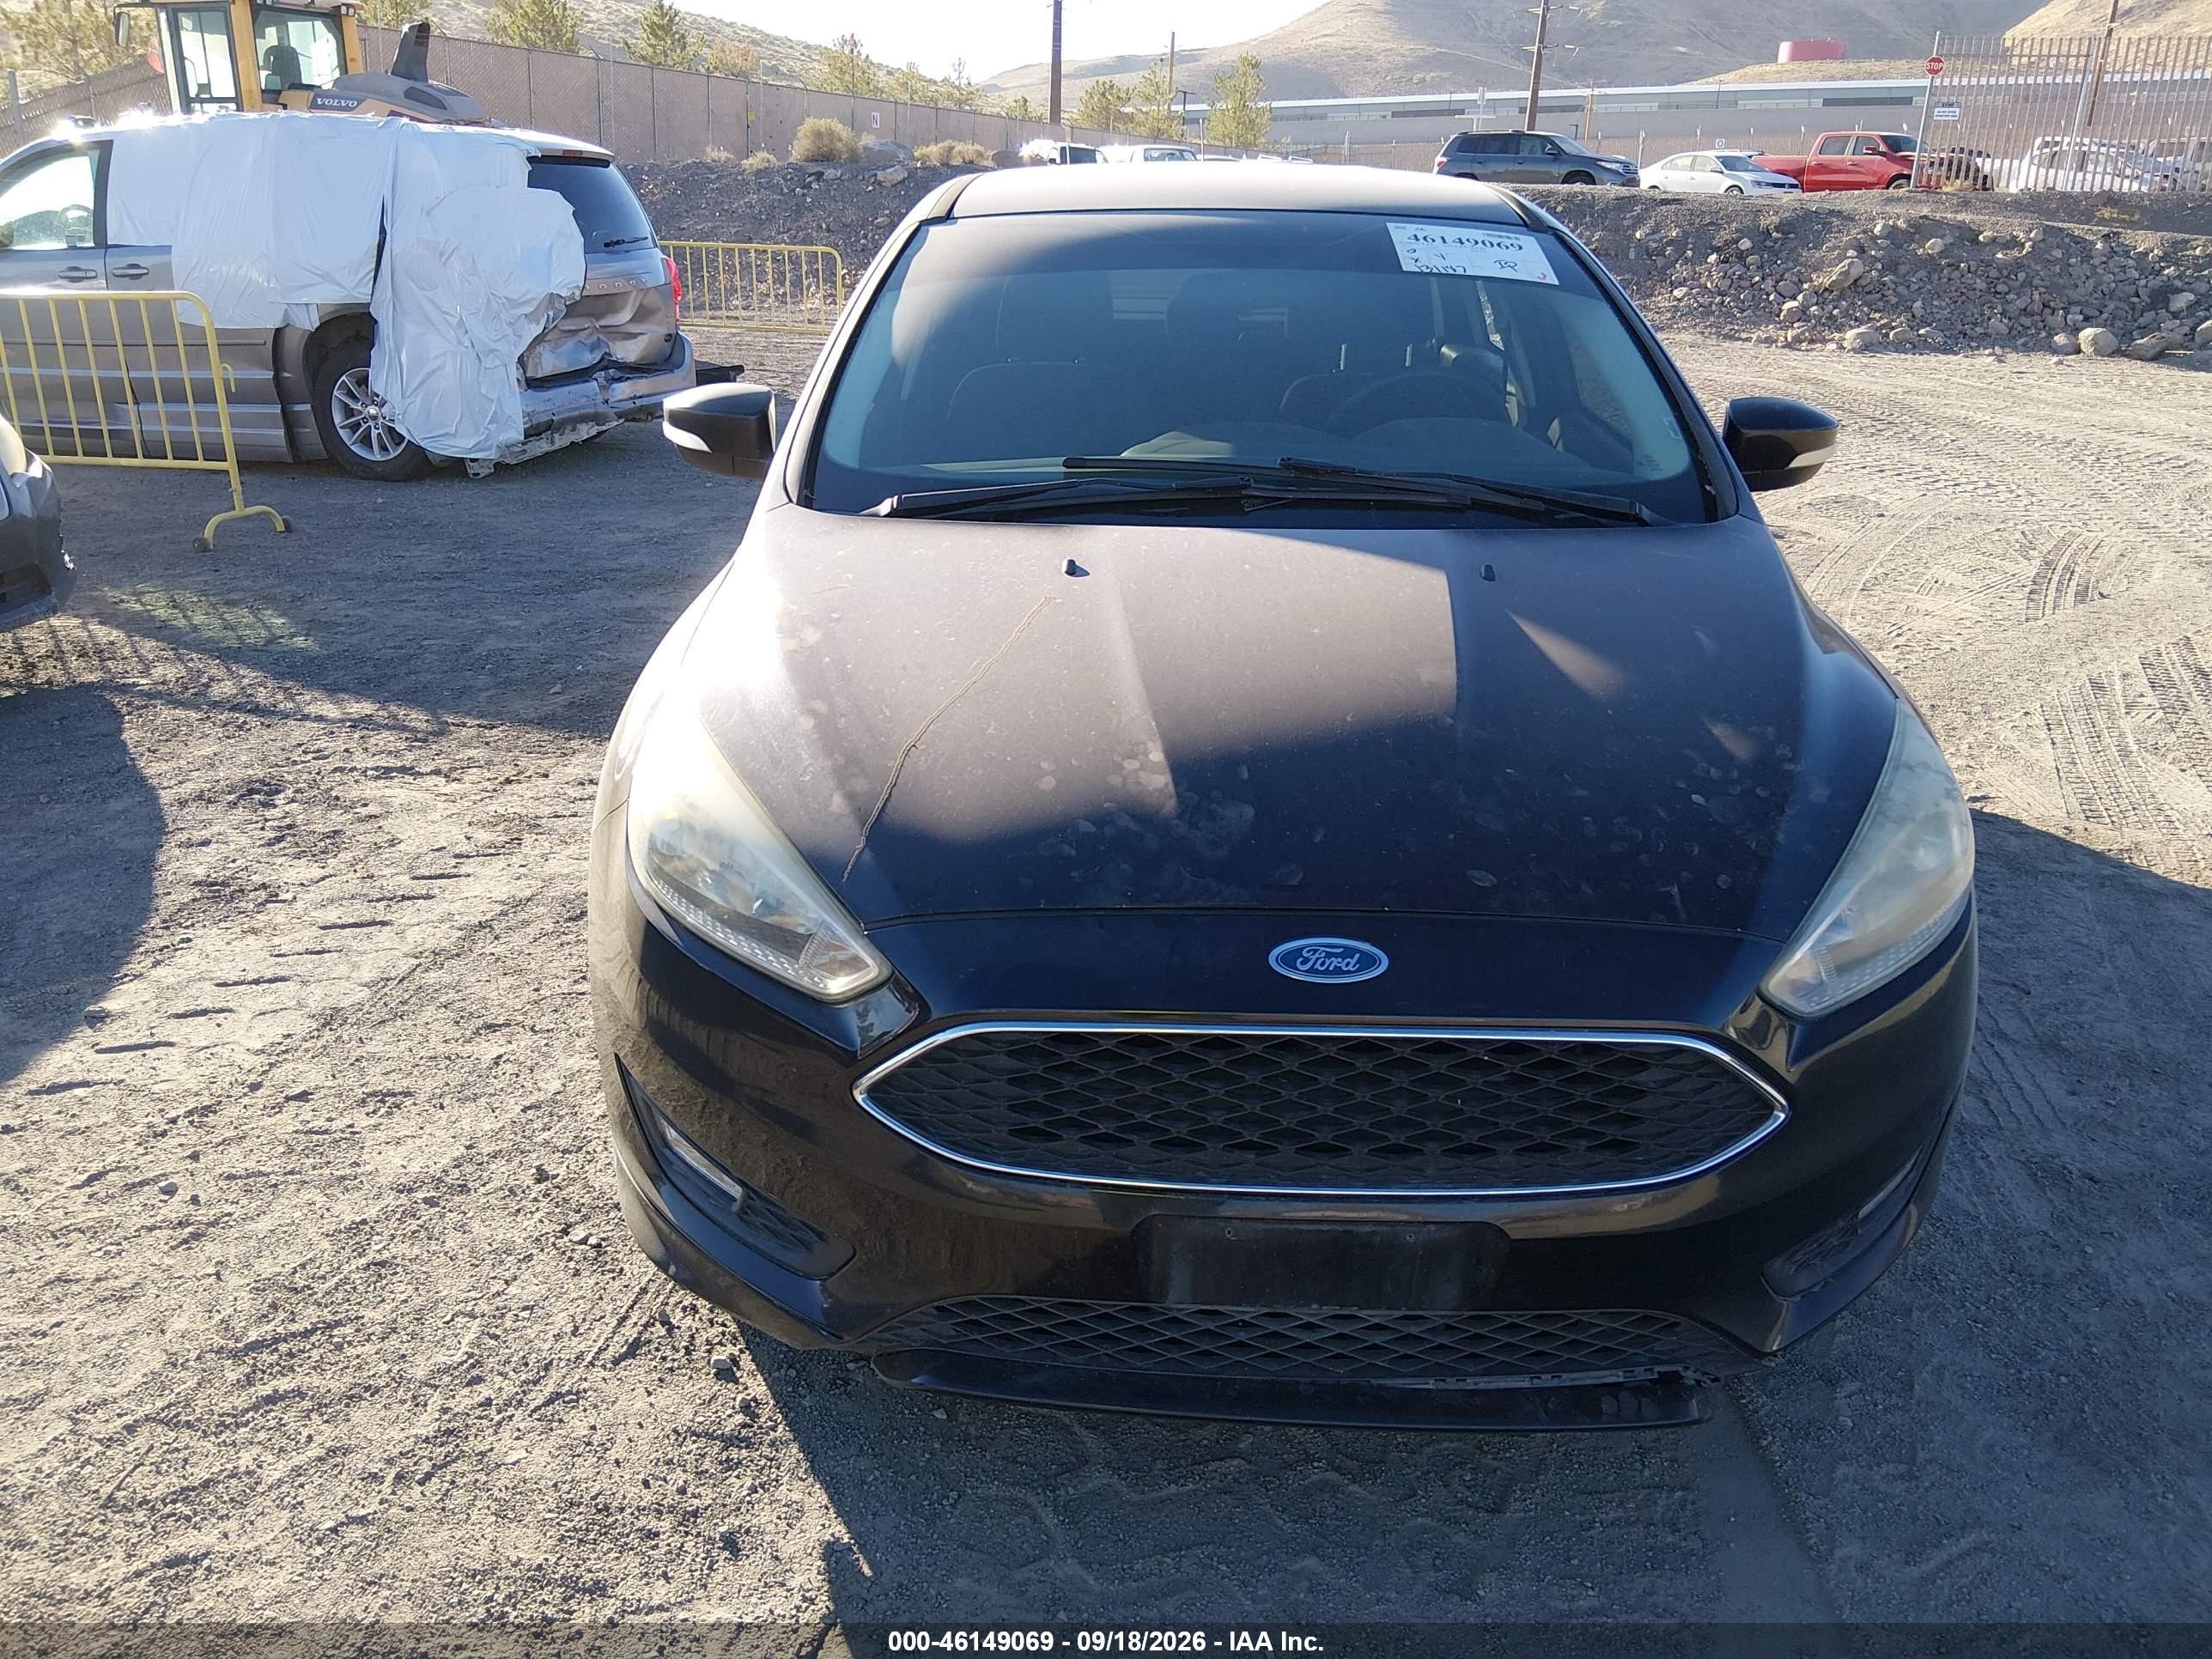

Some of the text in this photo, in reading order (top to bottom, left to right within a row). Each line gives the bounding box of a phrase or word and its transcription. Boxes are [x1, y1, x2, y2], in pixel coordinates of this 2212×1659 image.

[1926, 62, 1944, 70] STOP
[316, 98, 358, 107] VOLVO
[872, 113, 878, 126] N
[1407, 233, 1523, 252] 46149069
[1297, 946, 1360, 971] Ford
